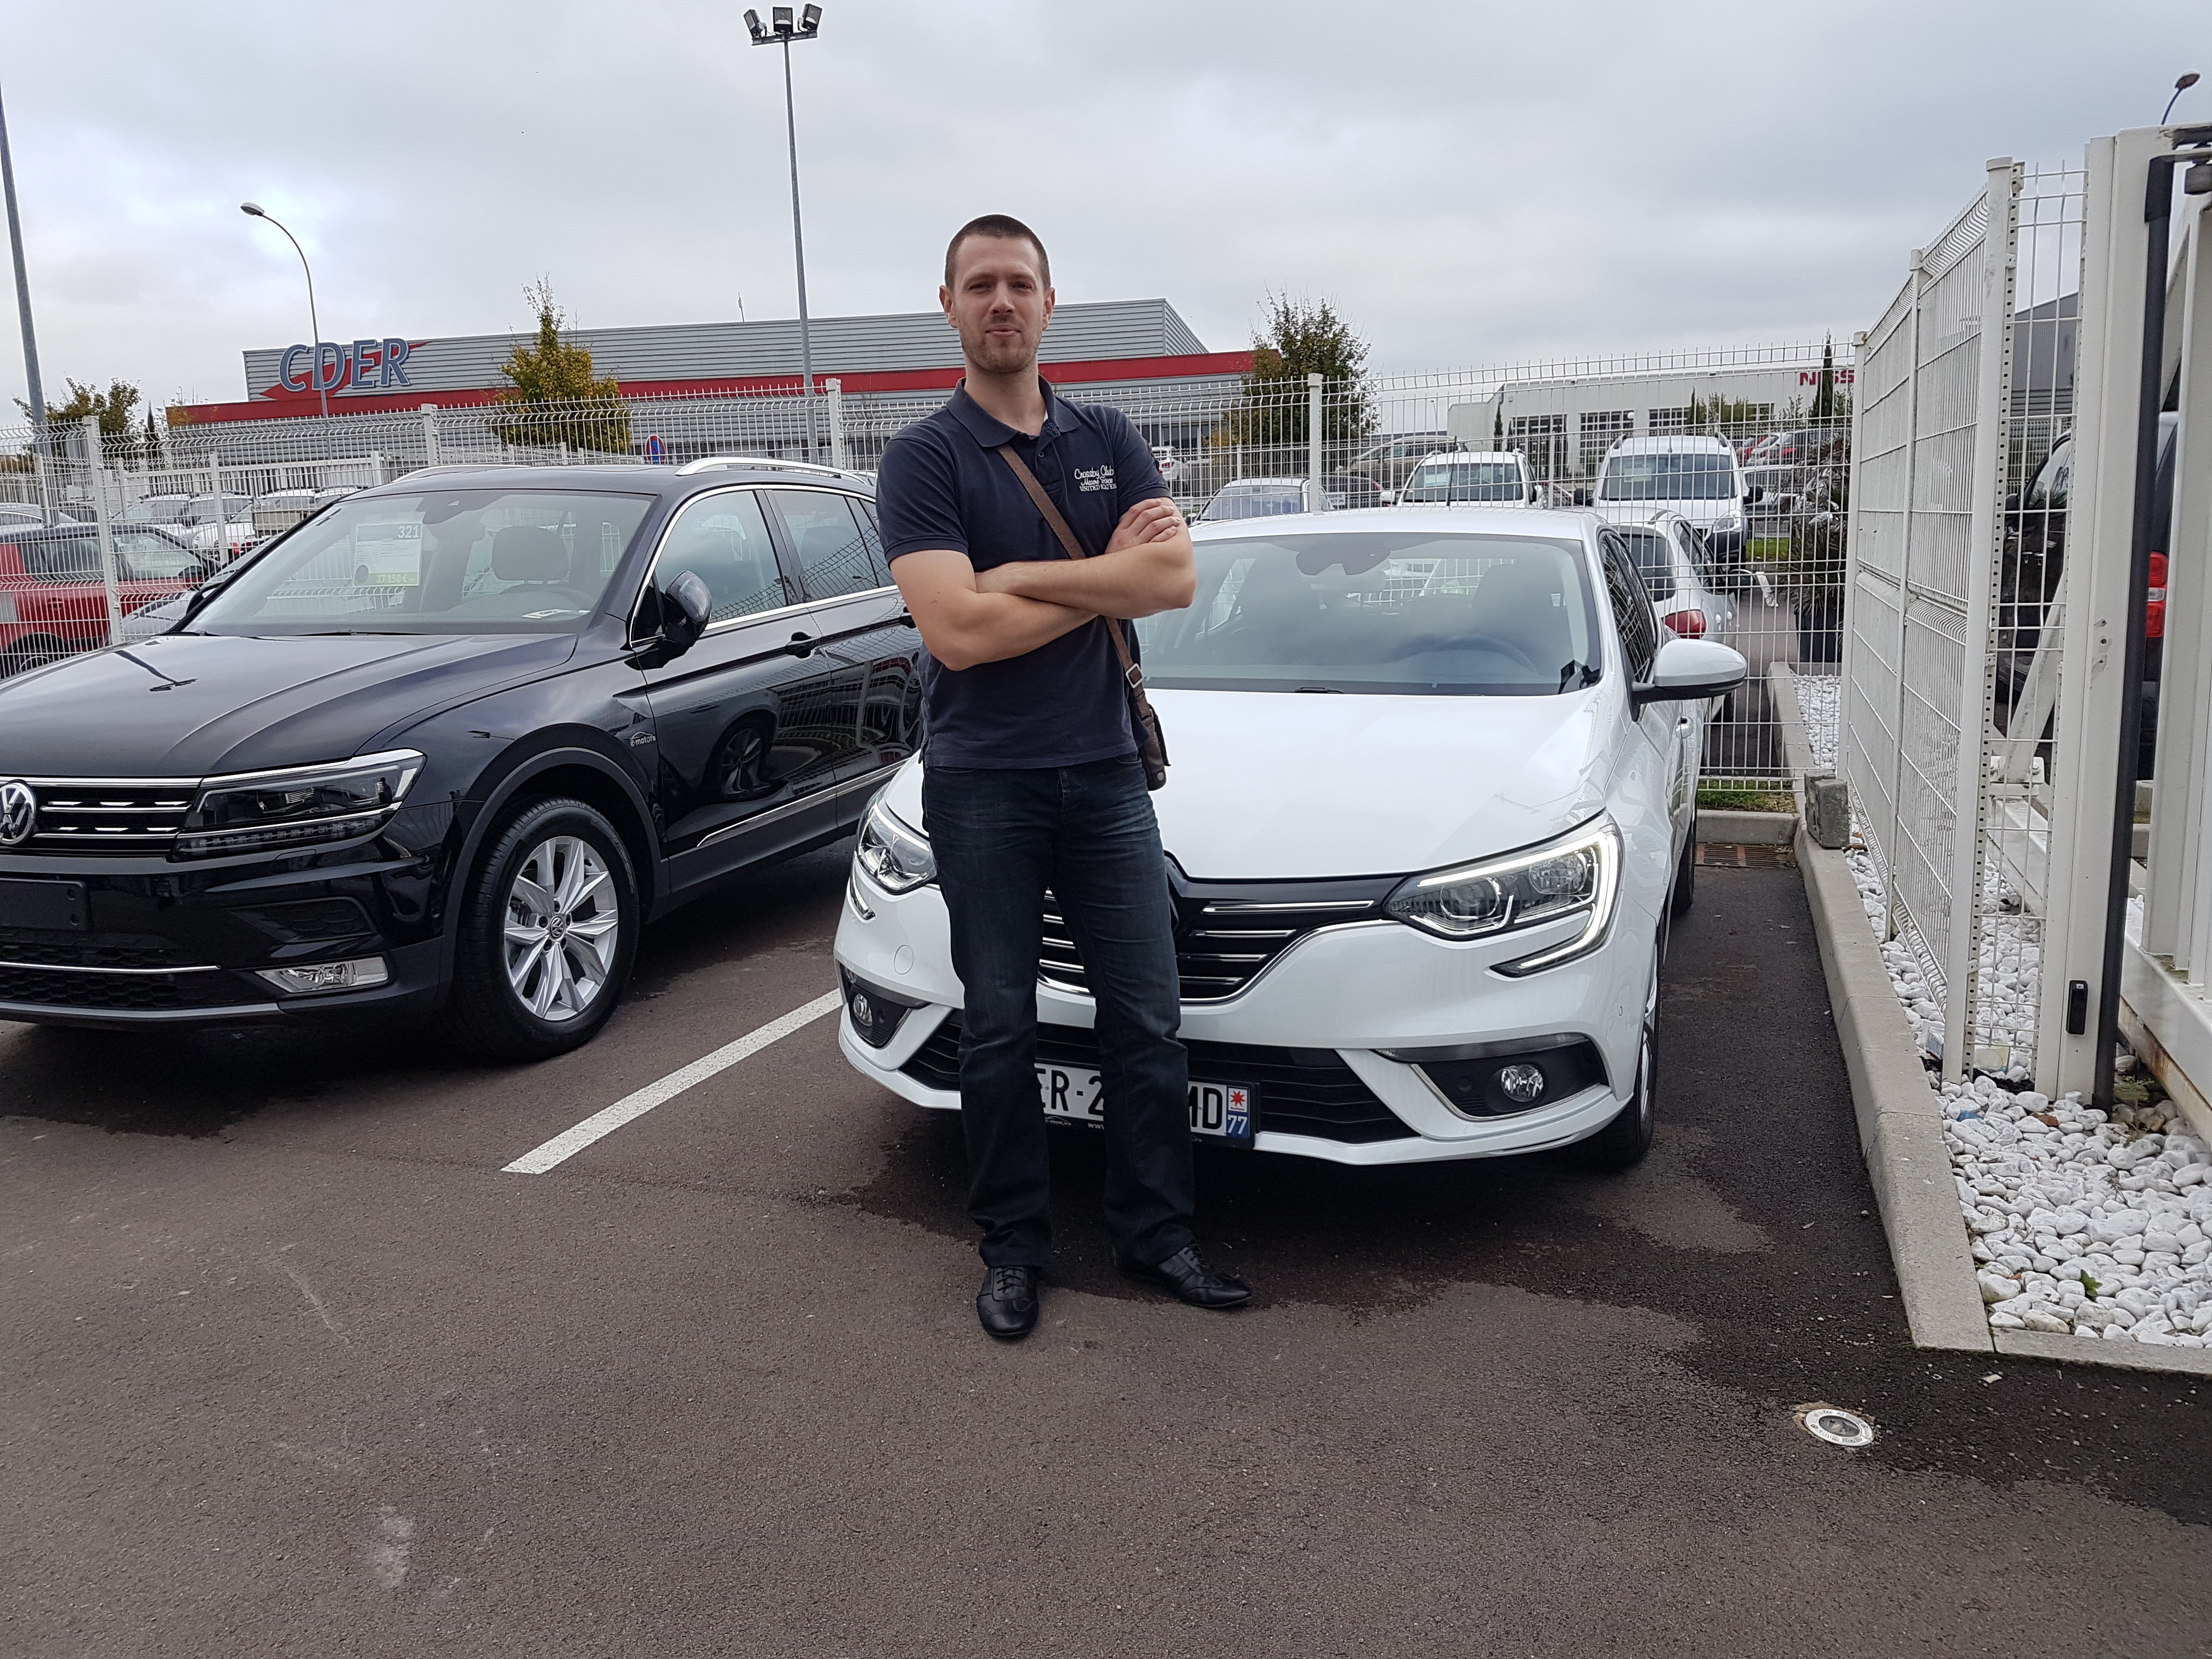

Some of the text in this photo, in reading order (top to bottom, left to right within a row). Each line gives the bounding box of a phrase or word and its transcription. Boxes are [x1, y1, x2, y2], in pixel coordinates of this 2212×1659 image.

[279, 338, 411, 393] CDER
[1074, 465, 1114, 479] Crossby Club
[398, 525, 419, 538] 321
[376, 574, 385, 583] 37
[388, 574, 401, 583] 150
[1227, 1114, 1248, 1135] 77
